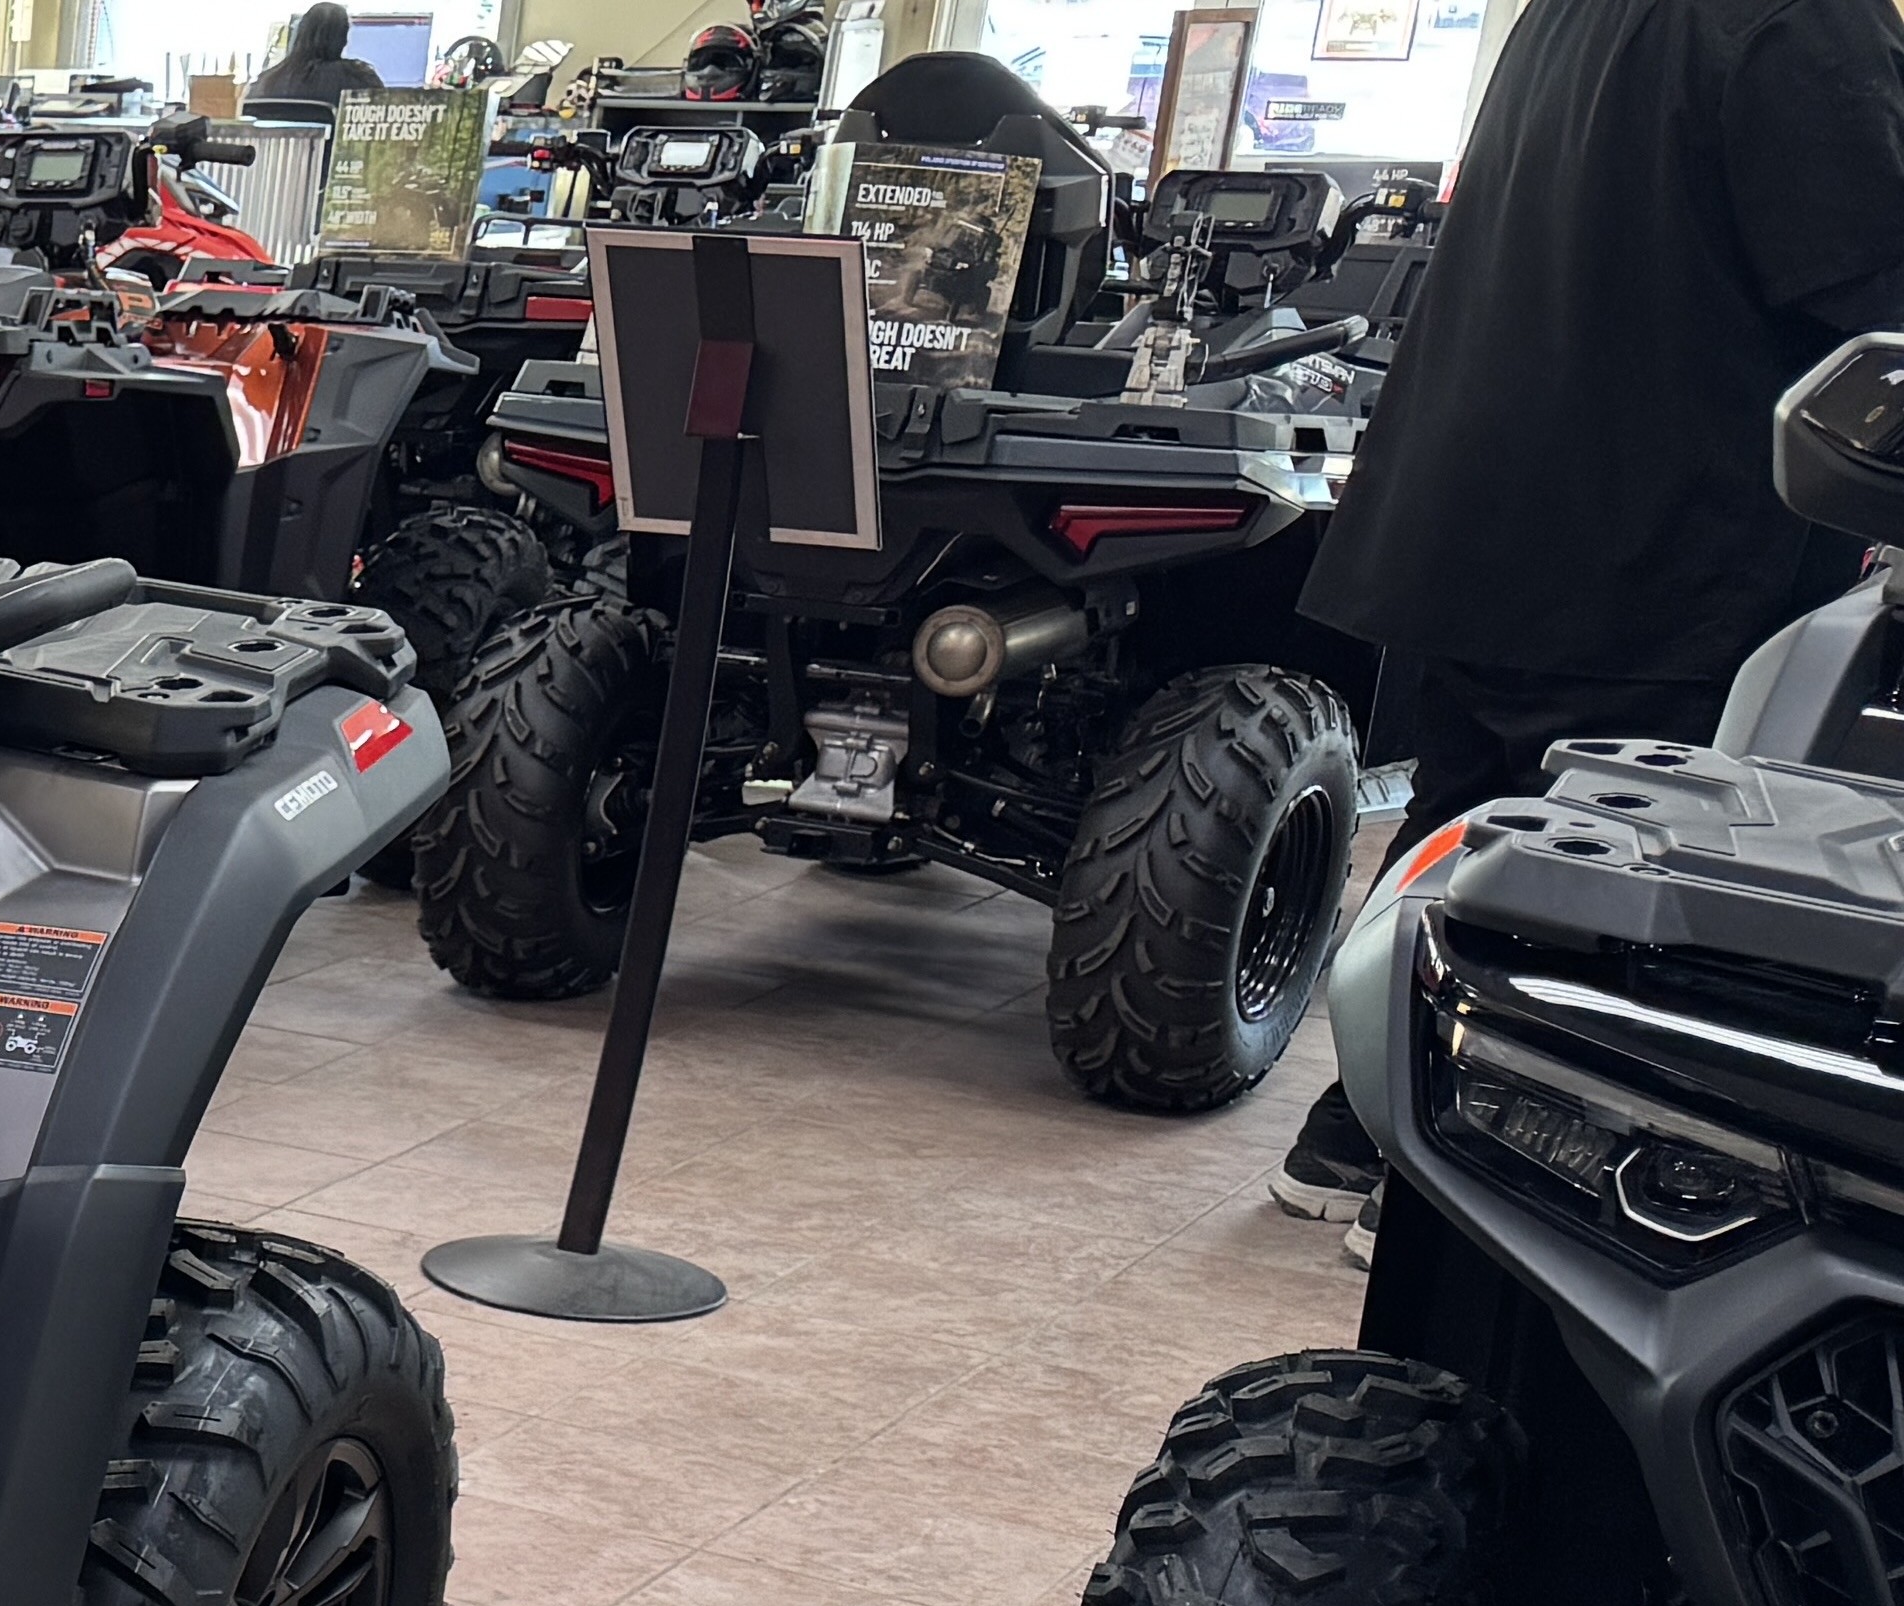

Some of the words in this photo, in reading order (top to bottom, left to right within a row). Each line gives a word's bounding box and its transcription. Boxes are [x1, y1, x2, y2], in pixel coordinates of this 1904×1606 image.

[343, 105, 386, 123] TOUGH
[387, 104, 446, 123] DOESN'T
[342, 123, 375, 141] TAKE
[375, 123, 390, 141] IT
[391, 123, 427, 141] EASY
[857, 183, 931, 207] EXTENDED
[873, 222, 895, 242] HP
[900, 322, 972, 351] DOESN'T
[871, 346, 916, 371] REAT
[0, 995, 50, 1010] WARNING
